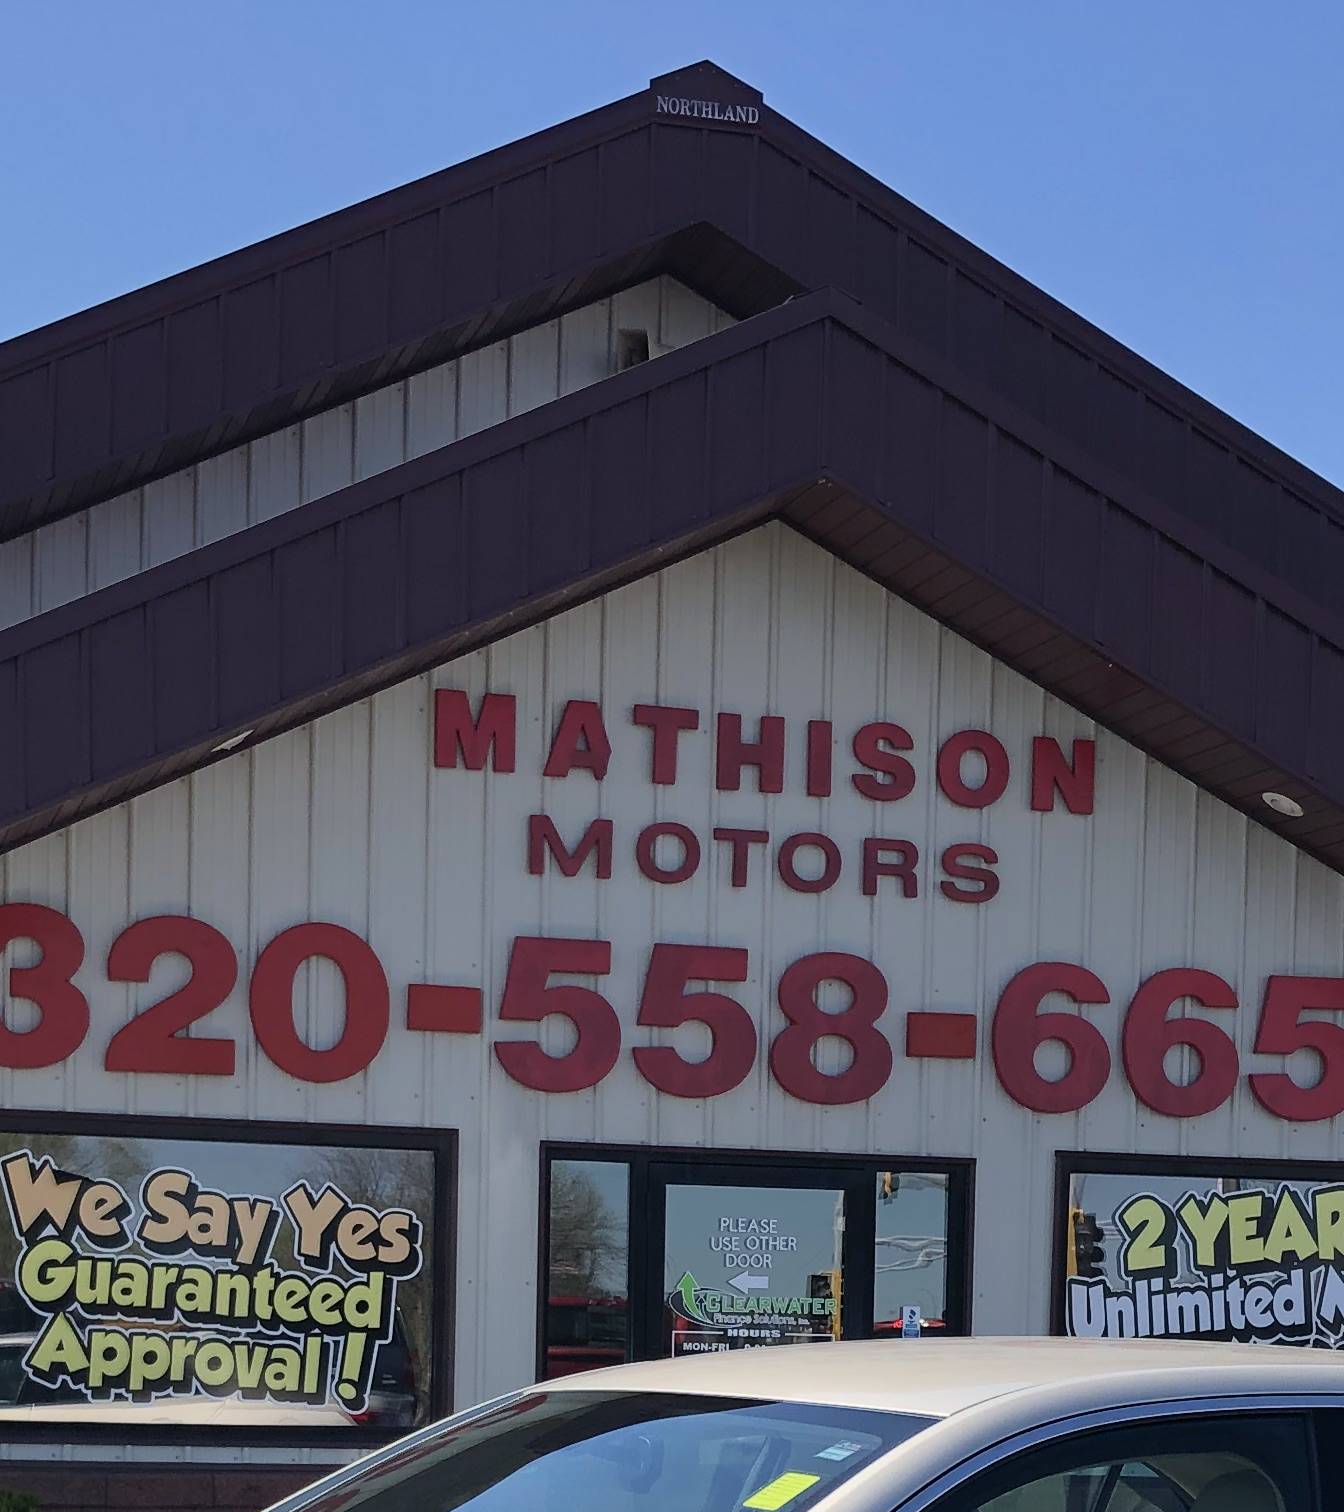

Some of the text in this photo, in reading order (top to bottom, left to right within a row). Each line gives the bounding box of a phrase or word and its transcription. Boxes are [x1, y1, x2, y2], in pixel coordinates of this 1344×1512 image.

[657, 95, 759, 124] NORTHLAND
[433, 689, 1096, 815] MATHISON
[527, 814, 1003, 904] MOTORS
[3, 1155, 414, 1265] We Say Yes
[719, 1217, 778, 1235] PLEASE
[1121, 1198, 1167, 1272] 2
[710, 1236, 798, 1252] USE OTHER
[725, 1253, 773, 1269] DOOR
[21, 1240, 386, 1329] Guaranteed
[706, 1293, 838, 1316] CLEARWATER
[1070, 1266, 1307, 1337] Unlimited
[713, 1313, 752, 1325] Finance
[727, 1328, 782, 1338] HOURS
[683, 1342, 730, 1352] MON-FRI
